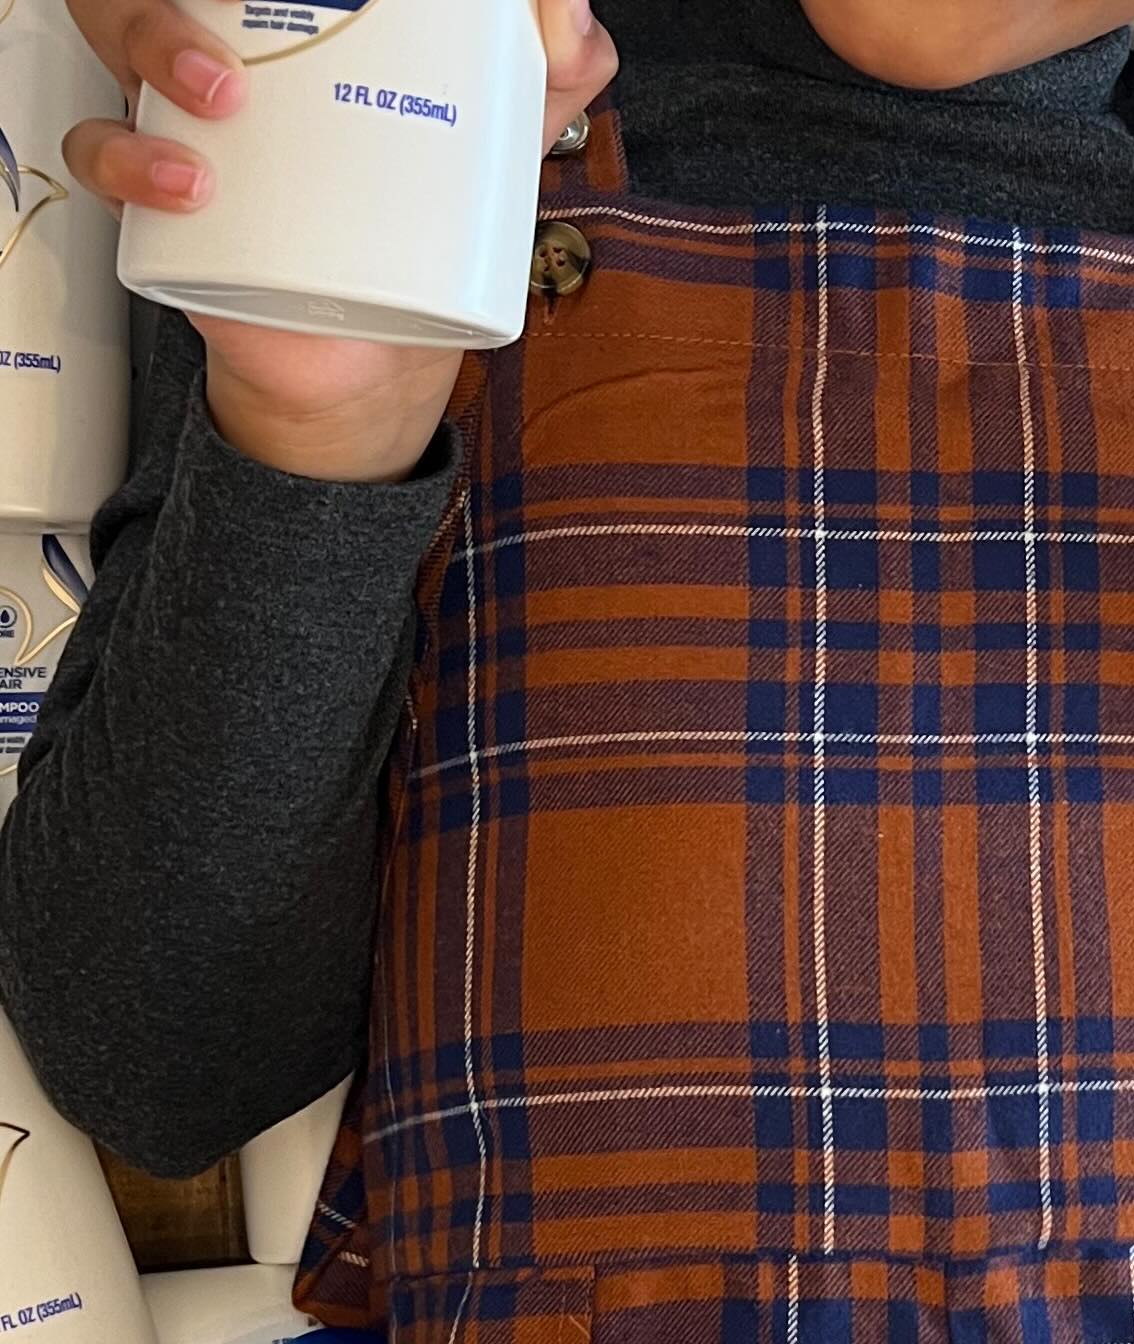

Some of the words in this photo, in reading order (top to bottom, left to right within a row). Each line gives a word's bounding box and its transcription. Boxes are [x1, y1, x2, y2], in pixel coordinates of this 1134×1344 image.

[334, 82, 352, 103] 12
[354, 85, 372, 106] FL
[376, 90, 397, 112] OZ
[399, 94, 458, 127] (355mL)
[14, 352, 61, 374] (355mL)
[19, 1307, 36, 1324] OZ
[36, 1292, 82, 1322] (355mL)
